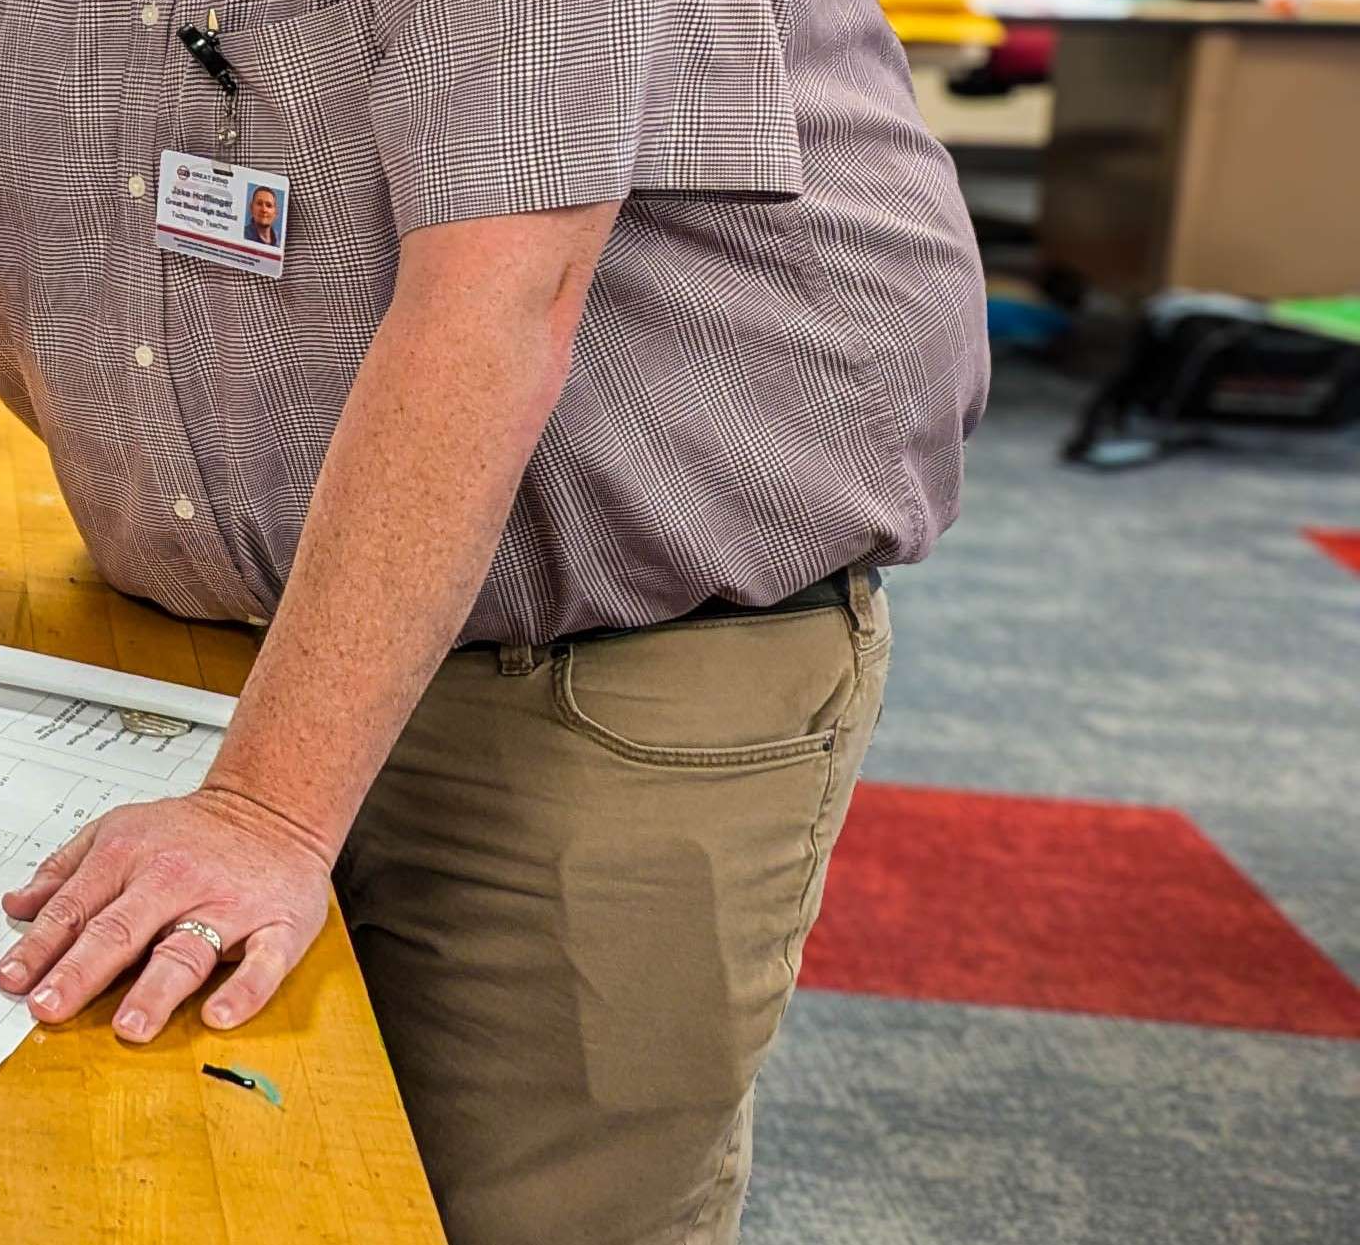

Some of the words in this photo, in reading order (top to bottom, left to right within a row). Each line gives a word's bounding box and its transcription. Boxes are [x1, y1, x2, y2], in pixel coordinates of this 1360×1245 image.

[172, 186, 191, 197] Jake
[165, 197, 182, 207] Great
[183, 202, 200, 212] Bend
[216, 210, 238, 221] School
